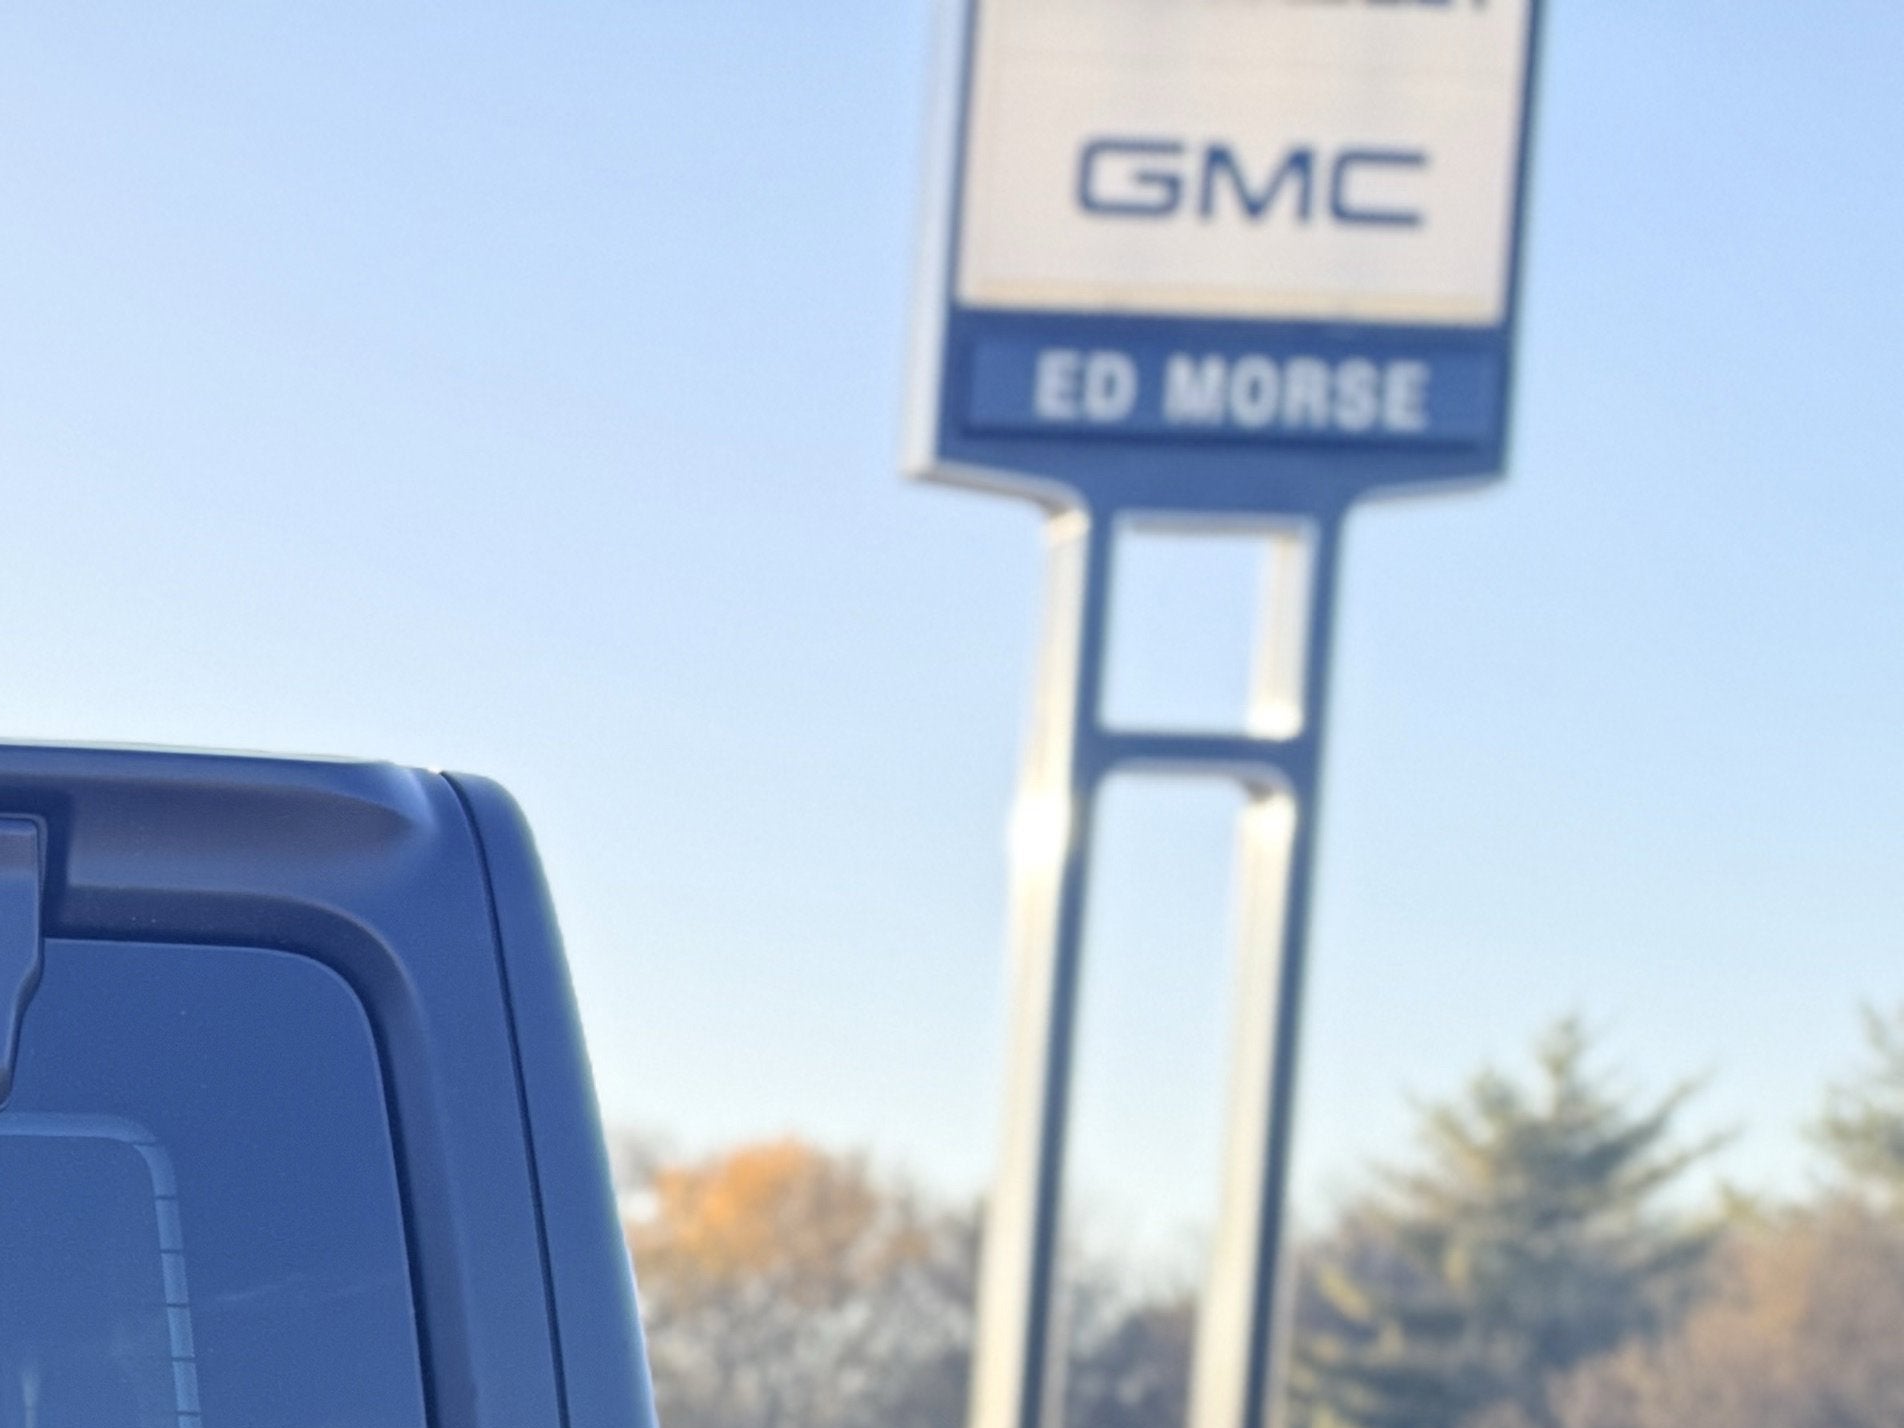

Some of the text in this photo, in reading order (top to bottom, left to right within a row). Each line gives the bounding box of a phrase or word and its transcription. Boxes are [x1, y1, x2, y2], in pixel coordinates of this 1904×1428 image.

[1076, 135, 1428, 227] GMC
[1034, 348, 1431, 432] ED MORSE
